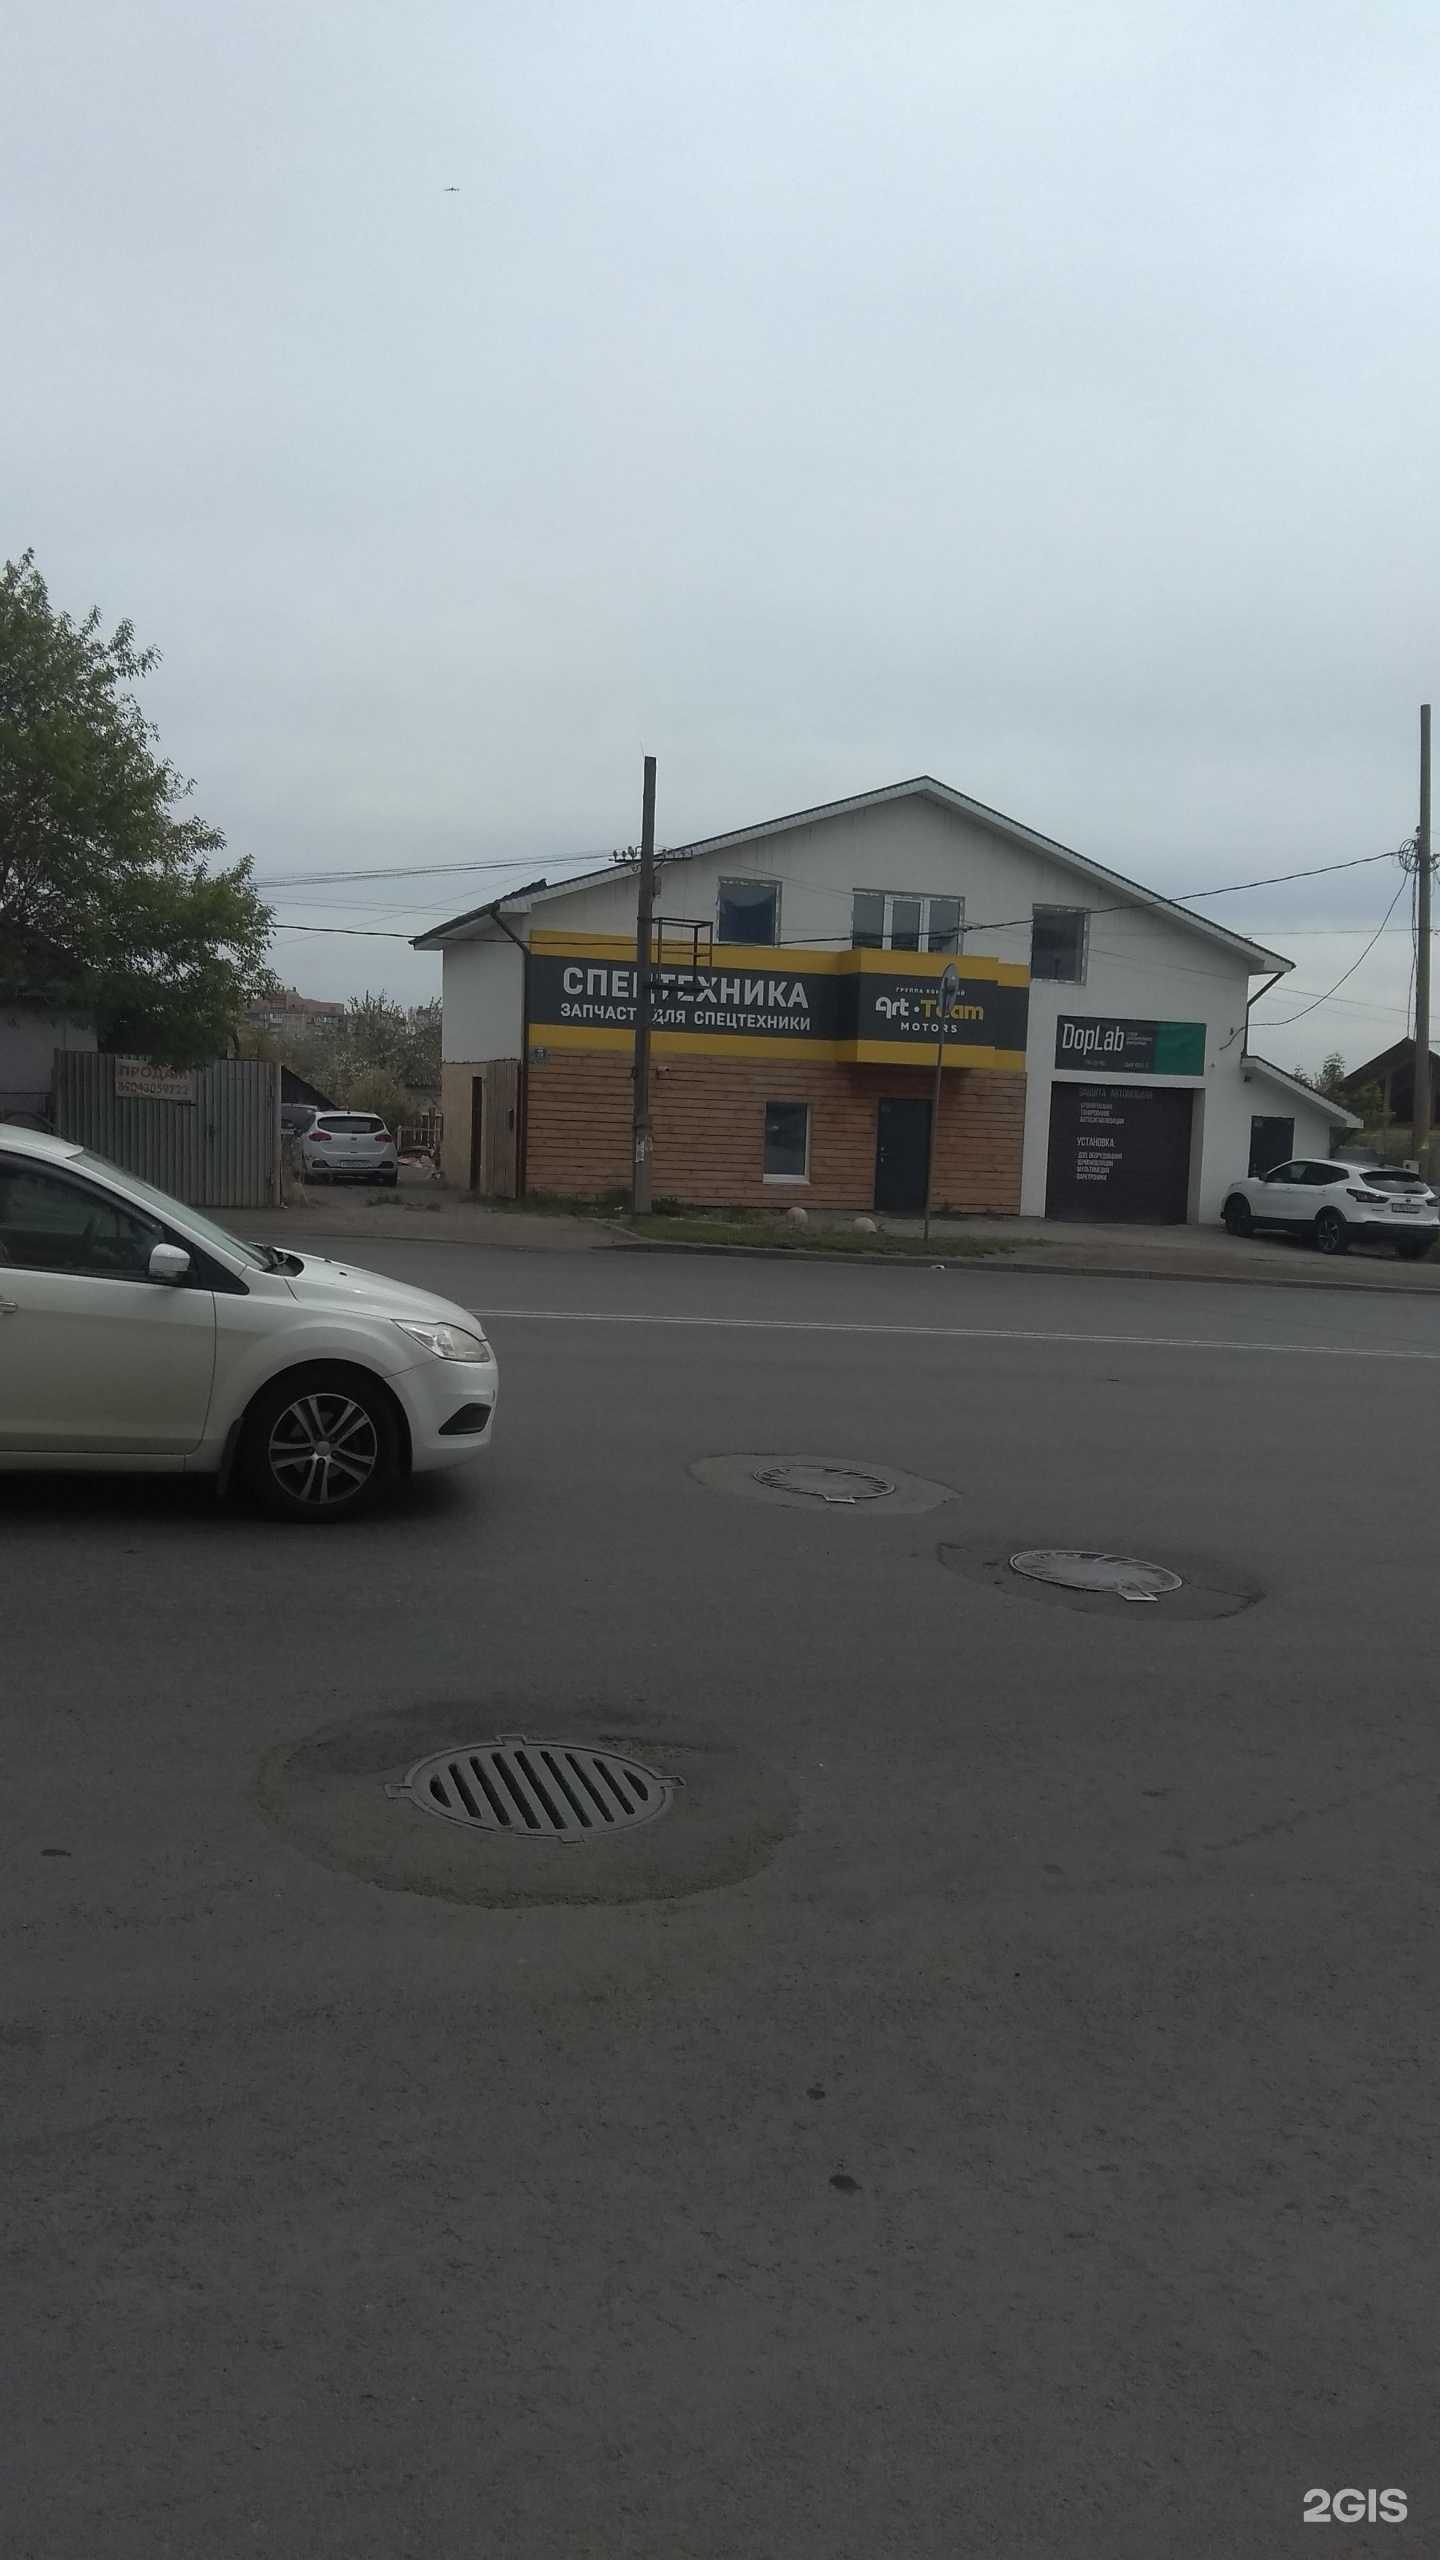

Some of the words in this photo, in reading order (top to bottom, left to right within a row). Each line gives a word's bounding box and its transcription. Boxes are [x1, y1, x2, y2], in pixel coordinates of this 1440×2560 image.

[560, 1002, 648, 1021] ЗАПЧАСТ
[651, 1008, 686, 1025] ДЛЯ
[694, 1010, 811, 1031] СПЕЦТЕХНИКИ
[900, 1021, 958, 1033] MOTORS
[1062, 1023, 1125, 1056] DopLab
[1076, 1136, 1115, 1147] УСТАНОВКА
